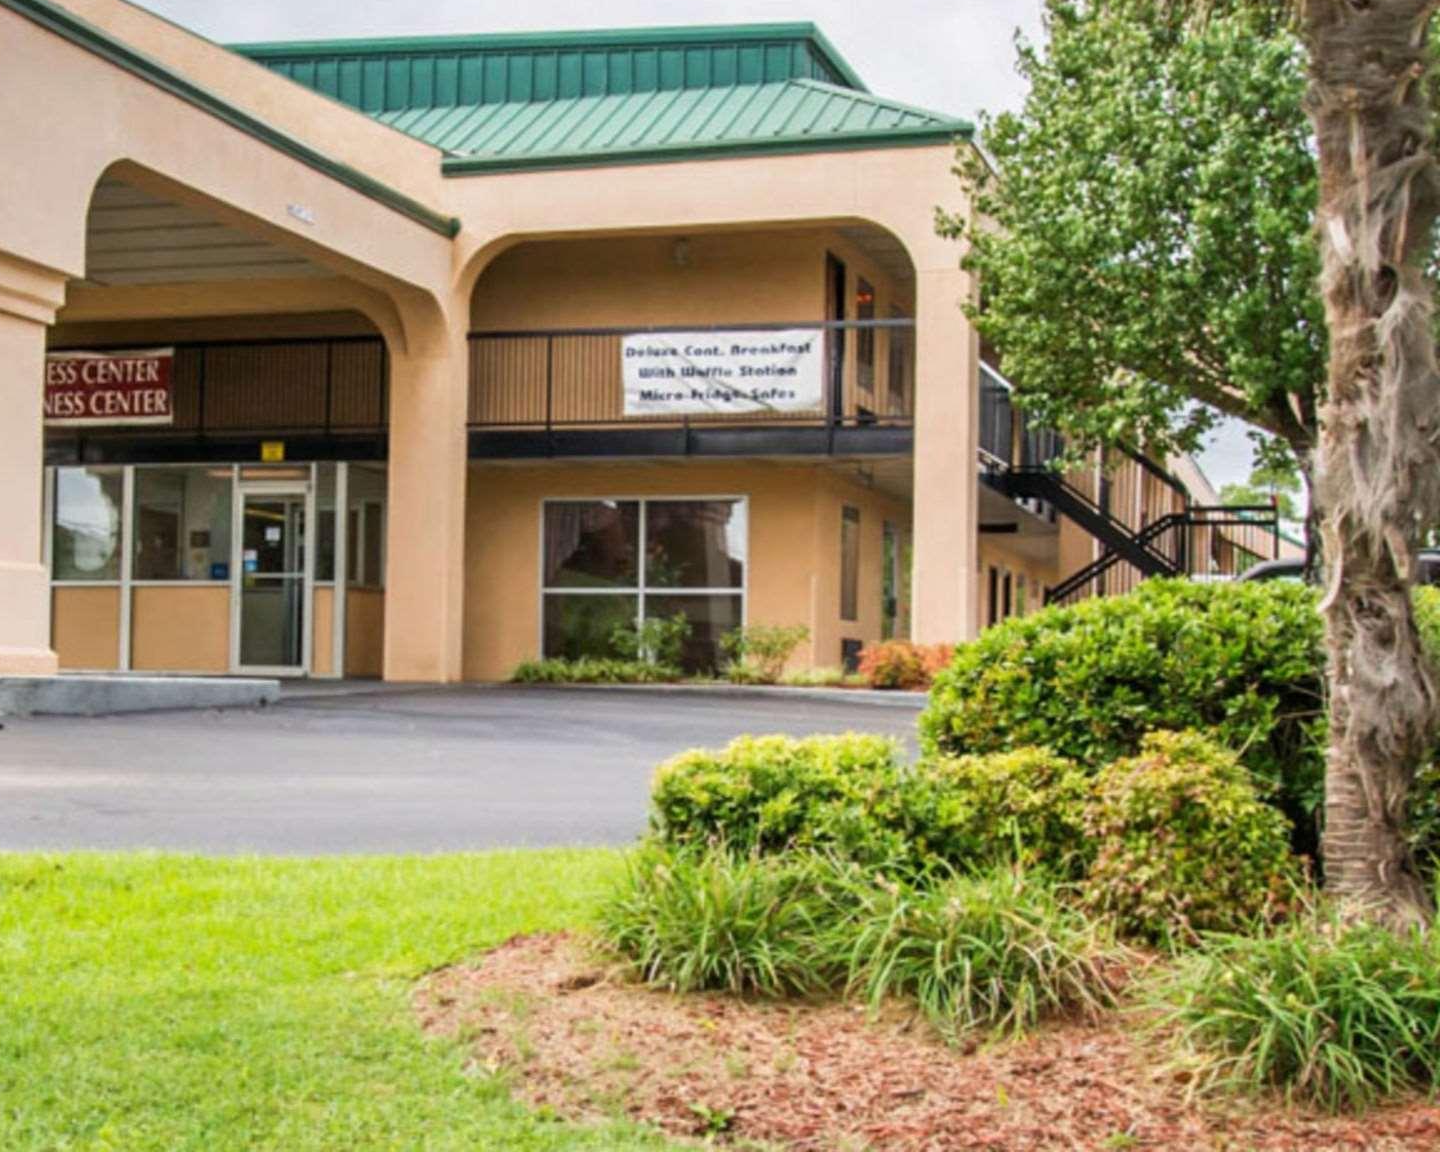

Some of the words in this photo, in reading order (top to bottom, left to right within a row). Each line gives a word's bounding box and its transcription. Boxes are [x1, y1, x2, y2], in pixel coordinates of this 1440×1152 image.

[625, 346, 678, 358] Deluxe
[684, 345, 725, 356] Cont.
[731, 342, 811, 355] Breakfast
[81, 359, 159, 384] CENTER
[638, 367, 675, 378] With
[681, 366, 732, 378] Waffle
[739, 366, 797, 377] Station
[90, 389, 166, 414] CENTER
